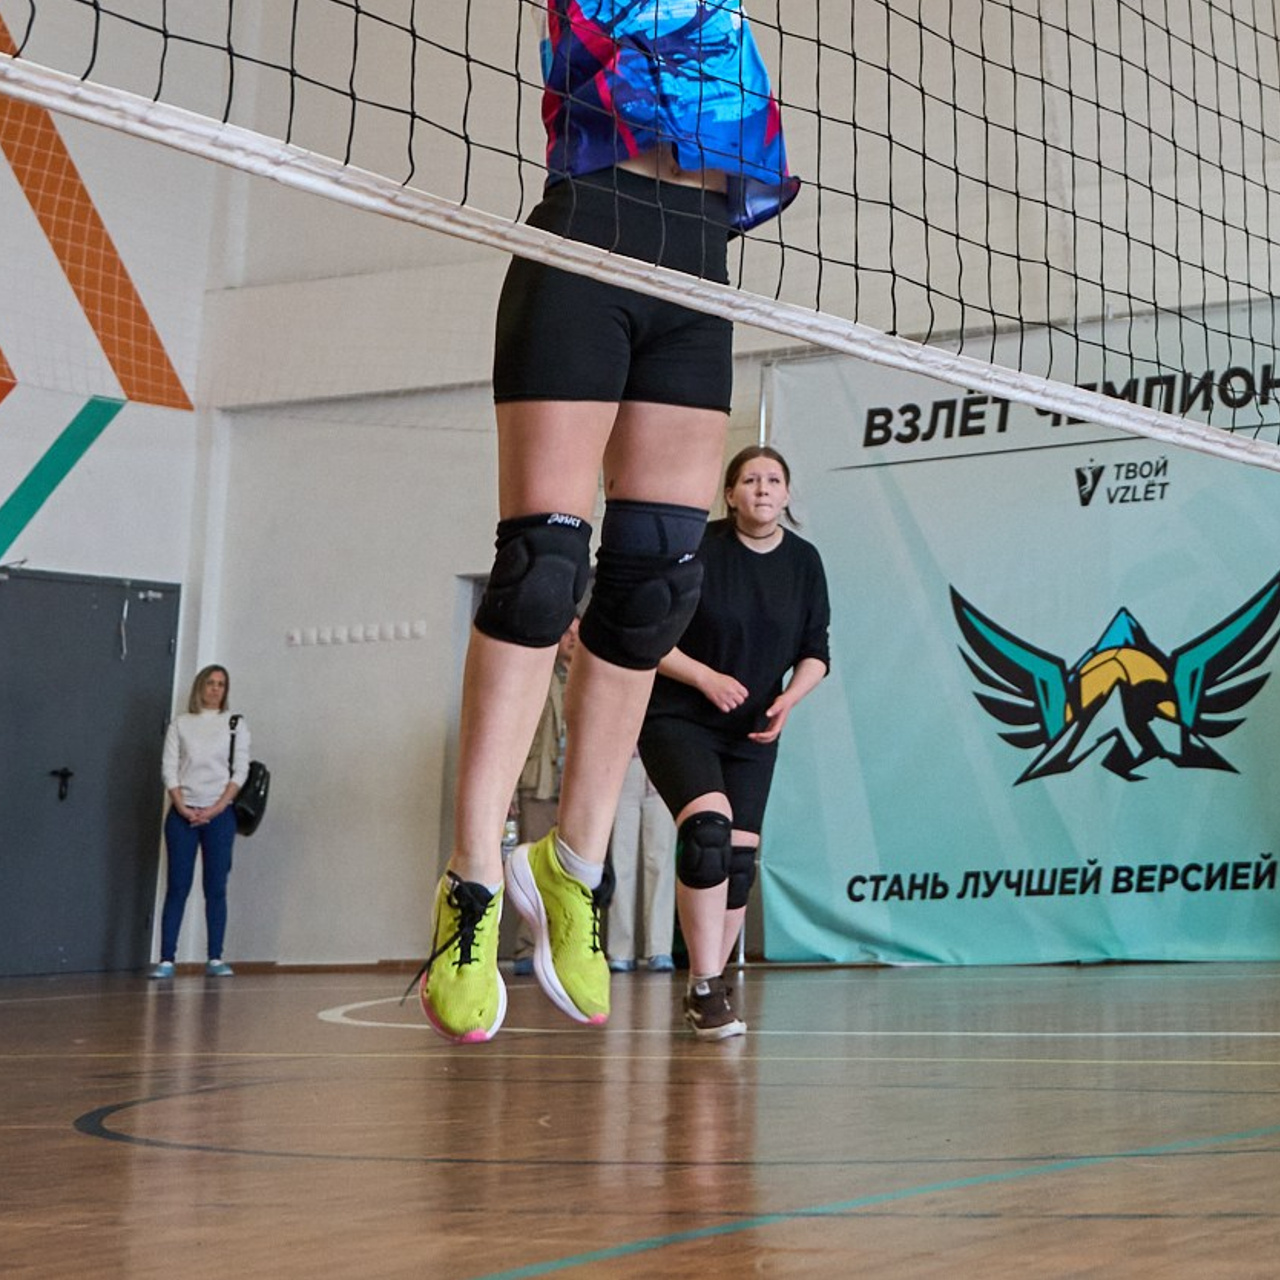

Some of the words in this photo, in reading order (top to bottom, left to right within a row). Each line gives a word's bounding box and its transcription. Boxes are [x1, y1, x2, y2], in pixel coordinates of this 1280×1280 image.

[1114, 455, 1168, 481] ТВОЙ
[846, 872, 949, 903] СТАНЬ
[957, 859, 1102, 899] ЛУЧШЕЙ
[1111, 853, 1277, 895] ВЕРСИЕЙ
